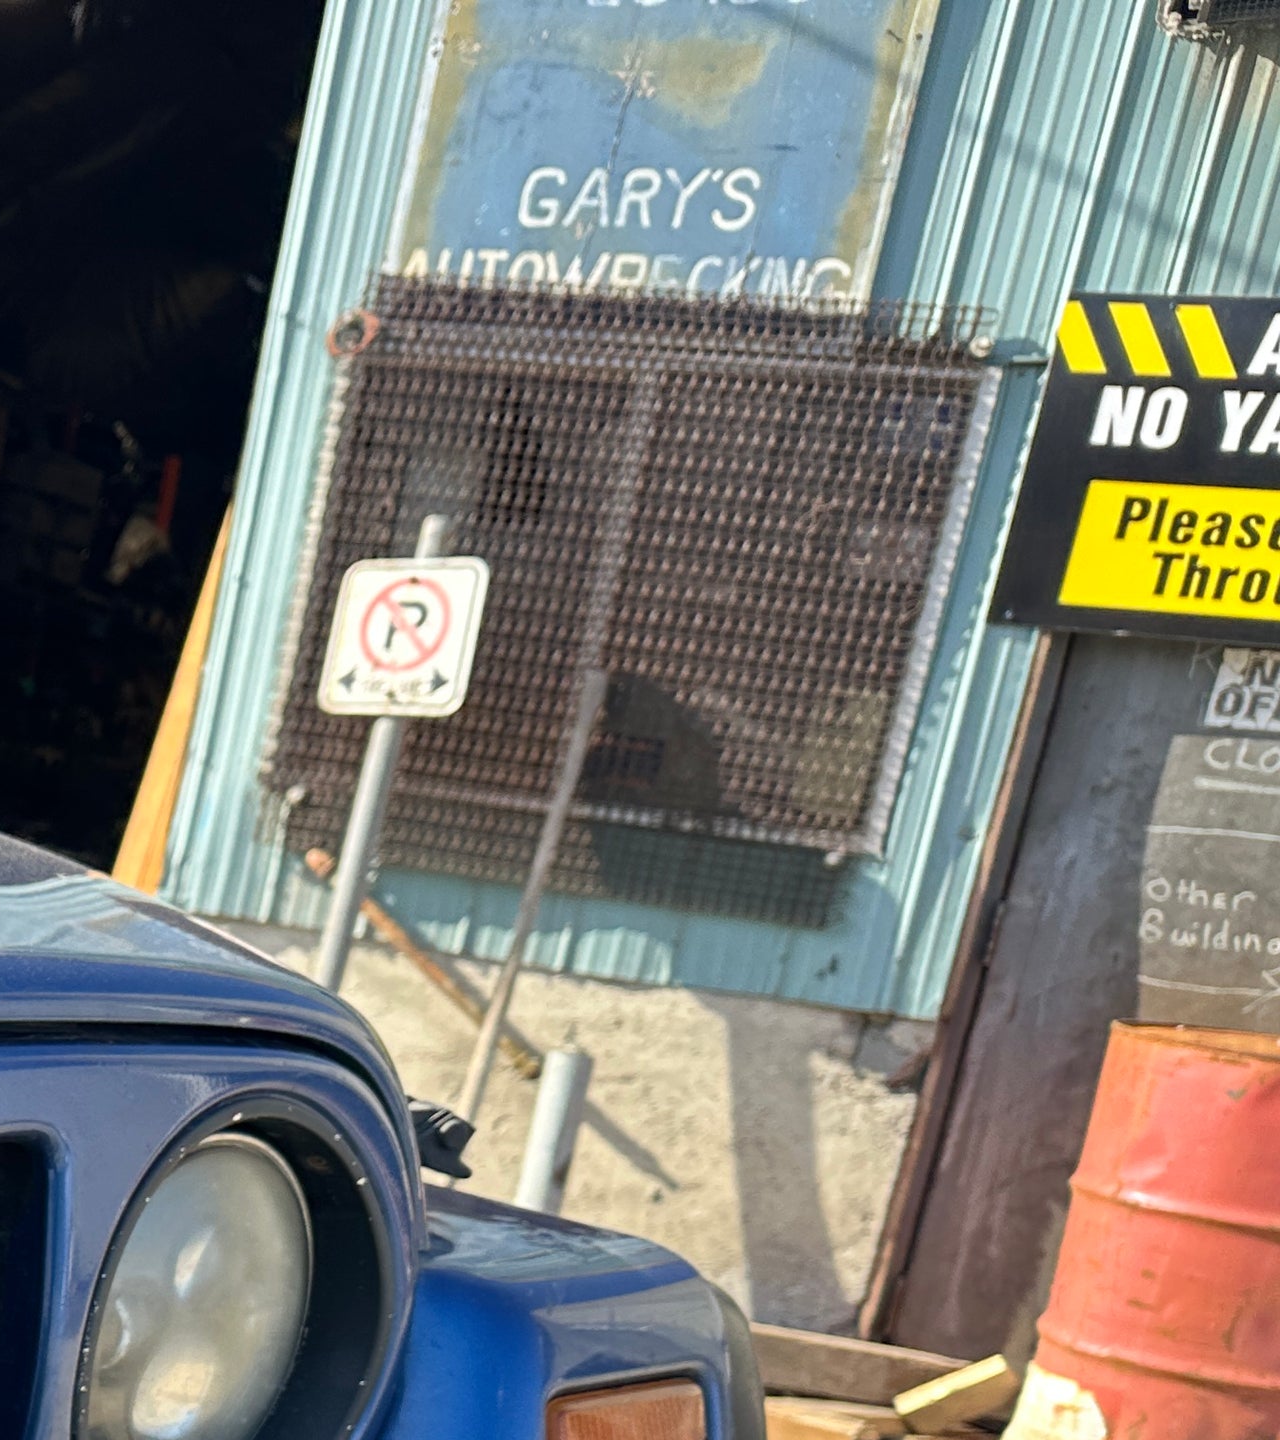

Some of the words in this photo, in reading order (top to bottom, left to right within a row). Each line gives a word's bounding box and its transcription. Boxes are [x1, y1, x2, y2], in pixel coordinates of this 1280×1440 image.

[517, 166, 762, 232] GARY'S
[1088, 384, 1189, 451] NO
[1219, 389, 1280, 454] YA
[1152, 551, 1280, 605] Thro
[1214, 683, 1280, 719] OF
[1146, 876, 1257, 911] Other
